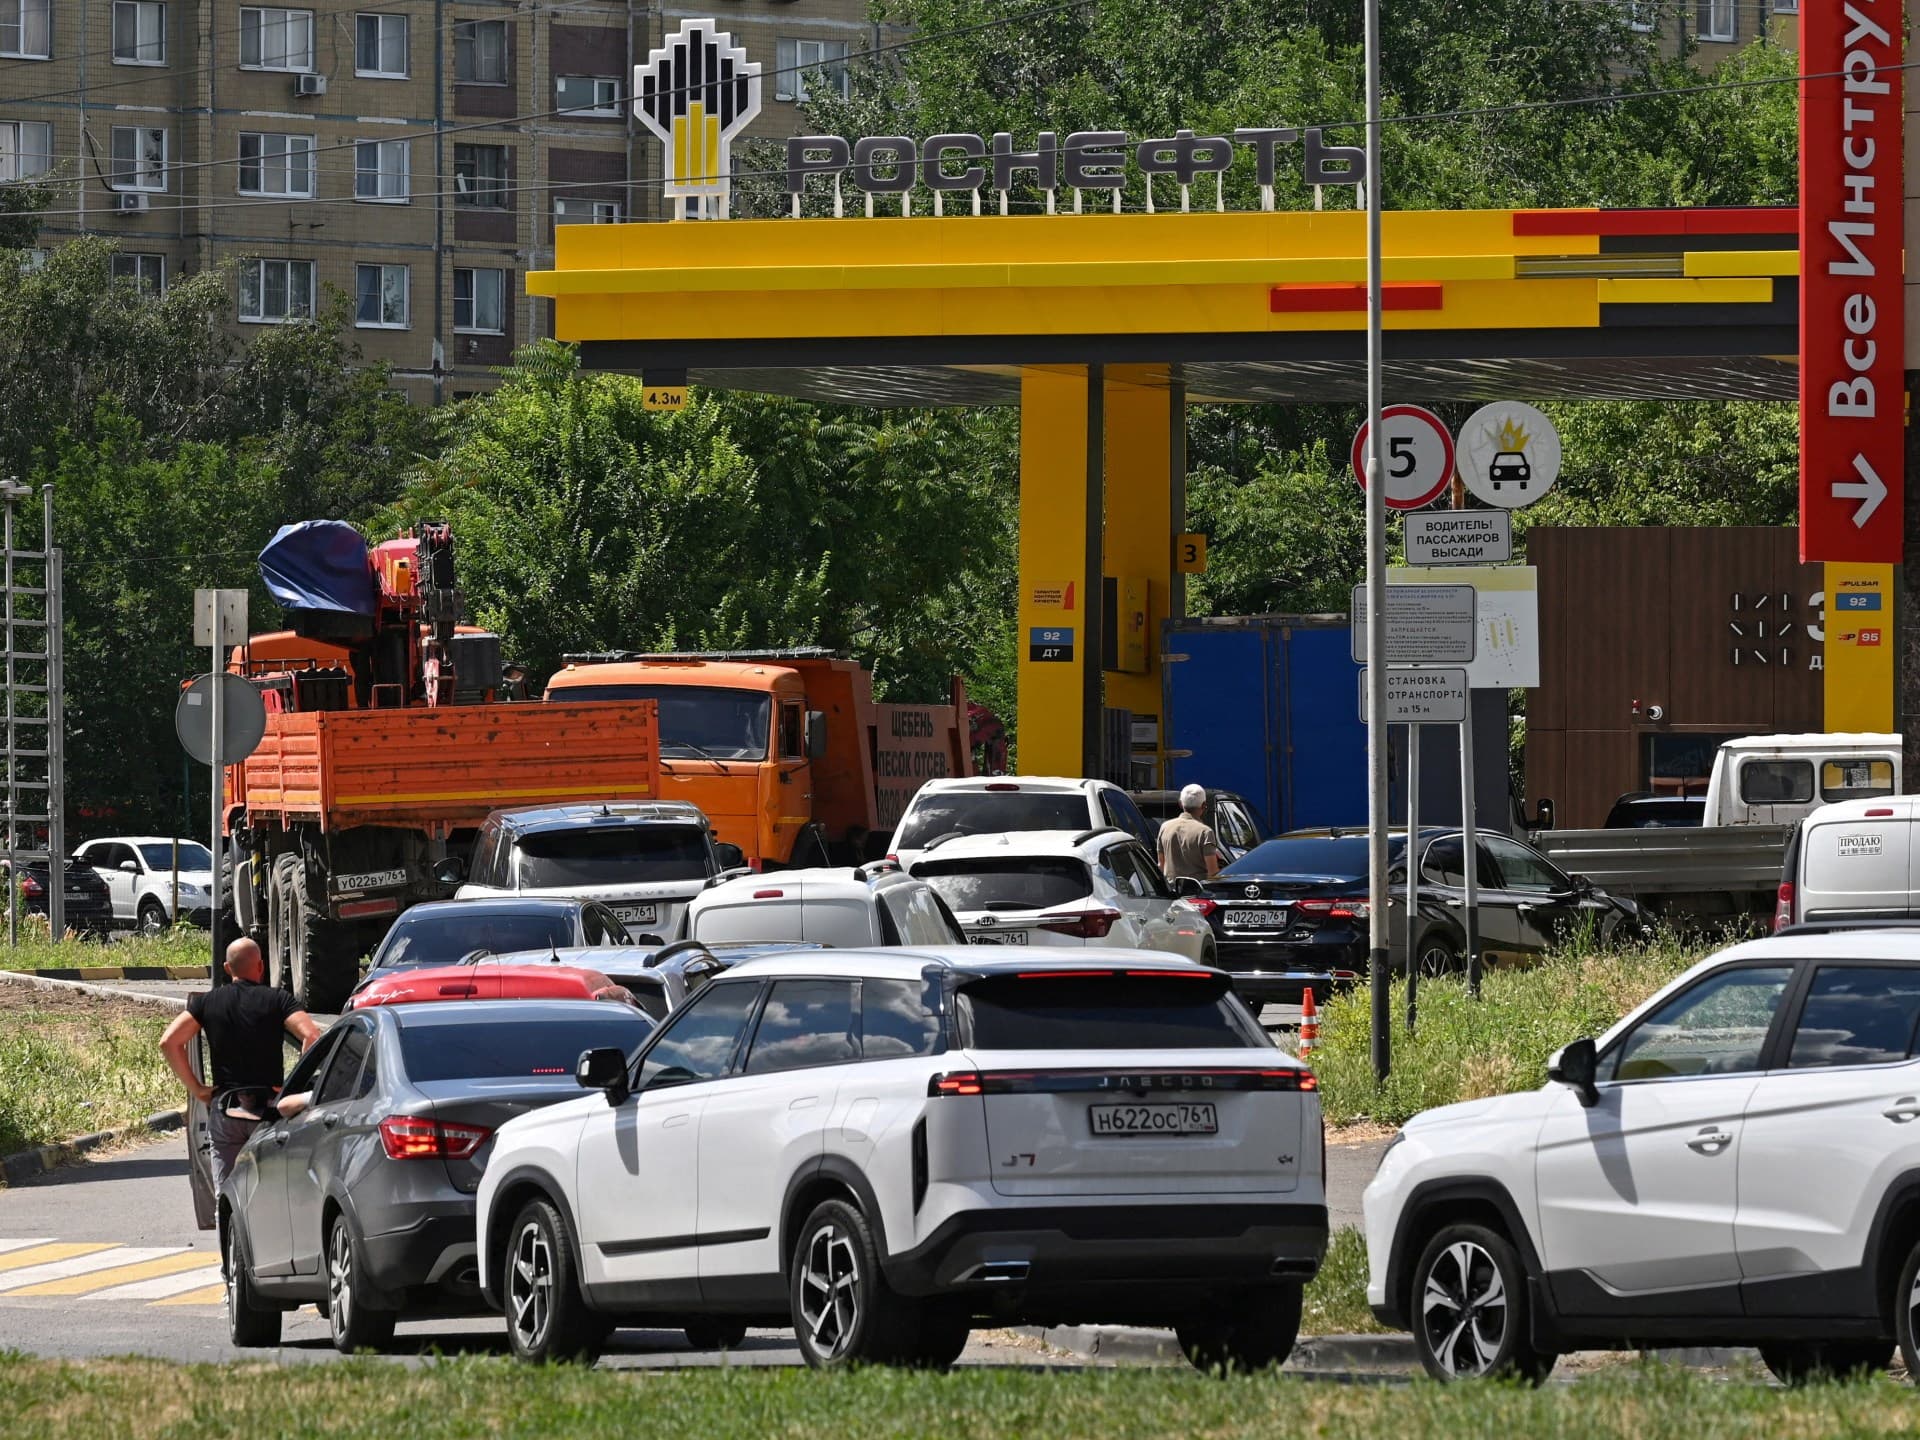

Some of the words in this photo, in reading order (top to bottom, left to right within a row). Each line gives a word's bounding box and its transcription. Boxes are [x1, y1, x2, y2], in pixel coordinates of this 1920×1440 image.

[1828, 0, 1891, 277] Инстру
[787, 128, 1367, 195] РОСНЕФТЬ
[1828, 292, 1877, 418] Все
[1390, 437, 1417, 478] 5
[1425, 520, 1493, 532] ВОДИТЕЛЬ!
[1416, 533, 1500, 545] ПАССАЖИРОВ
[1183, 543, 1197, 563] 3
[1431, 547, 1484, 558] ВЫСАДИ
[1849, 597, 1867, 607] 92
[1043, 631, 1061, 641] 92
[1861, 633, 1879, 642] 95
[1042, 648, 1061, 658] ДТ
[1388, 676, 1446, 686] СТАНОВКА
[1388, 690, 1464, 700] ОТРАНСПОРТА
[1397, 706, 1409, 714] за
[1411, 704, 1421, 714] 15
[891, 711, 934, 741] ЩЕБЕНЬ
[878, 750, 912, 777] ПЕСОК
[914, 751, 946, 777] ОТСЕВ
[1840, 836, 1881, 847] ПРОДАЮ
[386, 869, 404, 881] 761
[633, 906, 653, 918] 761
[1269, 911, 1285, 921] 761
[1004, 933, 1024, 944] 761
[1098, 1075, 1214, 1087] JAECOO
[1098, 1107, 1179, 1130] Н622ОС
[1180, 1106, 1212, 1123] 761
